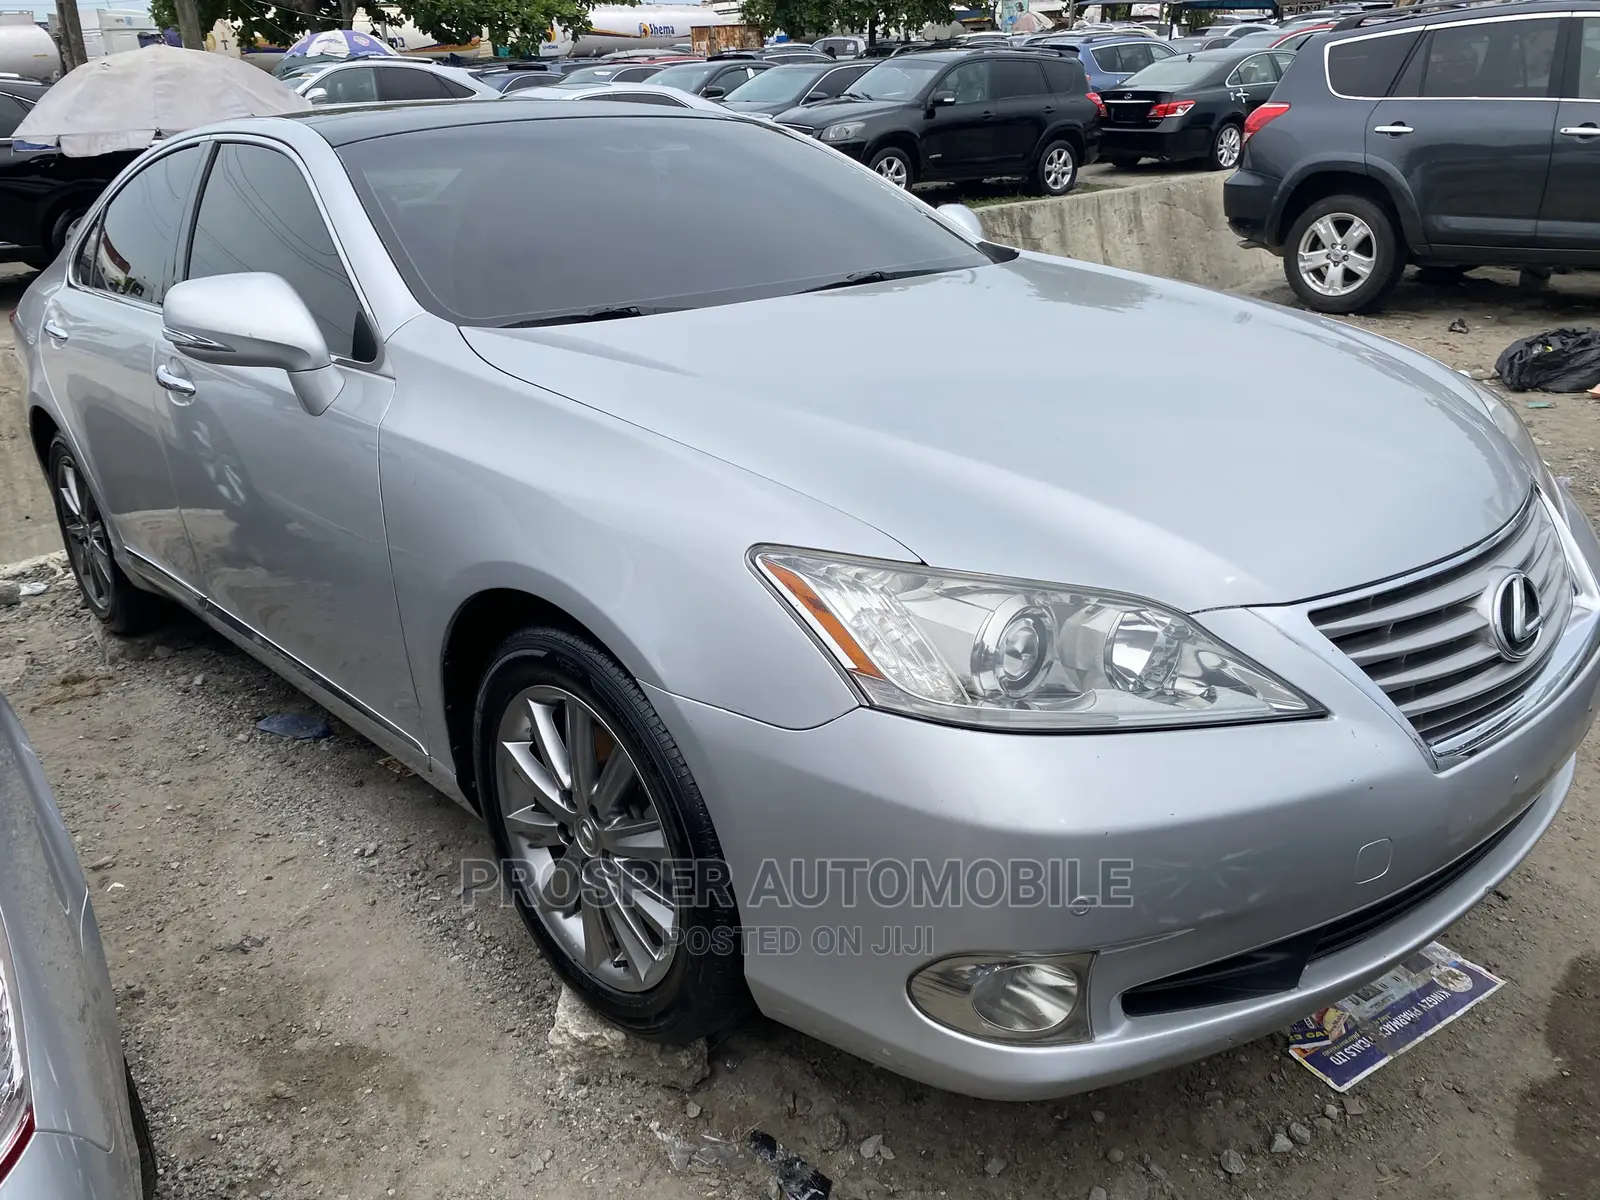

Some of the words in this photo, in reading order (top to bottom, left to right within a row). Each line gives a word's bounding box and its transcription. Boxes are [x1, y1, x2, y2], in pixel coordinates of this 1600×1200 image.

[648, 23, 674, 34] Shema
[1417, 989, 1451, 1011] KINGZY
[1329, 1051, 1350, 1066] LTD
